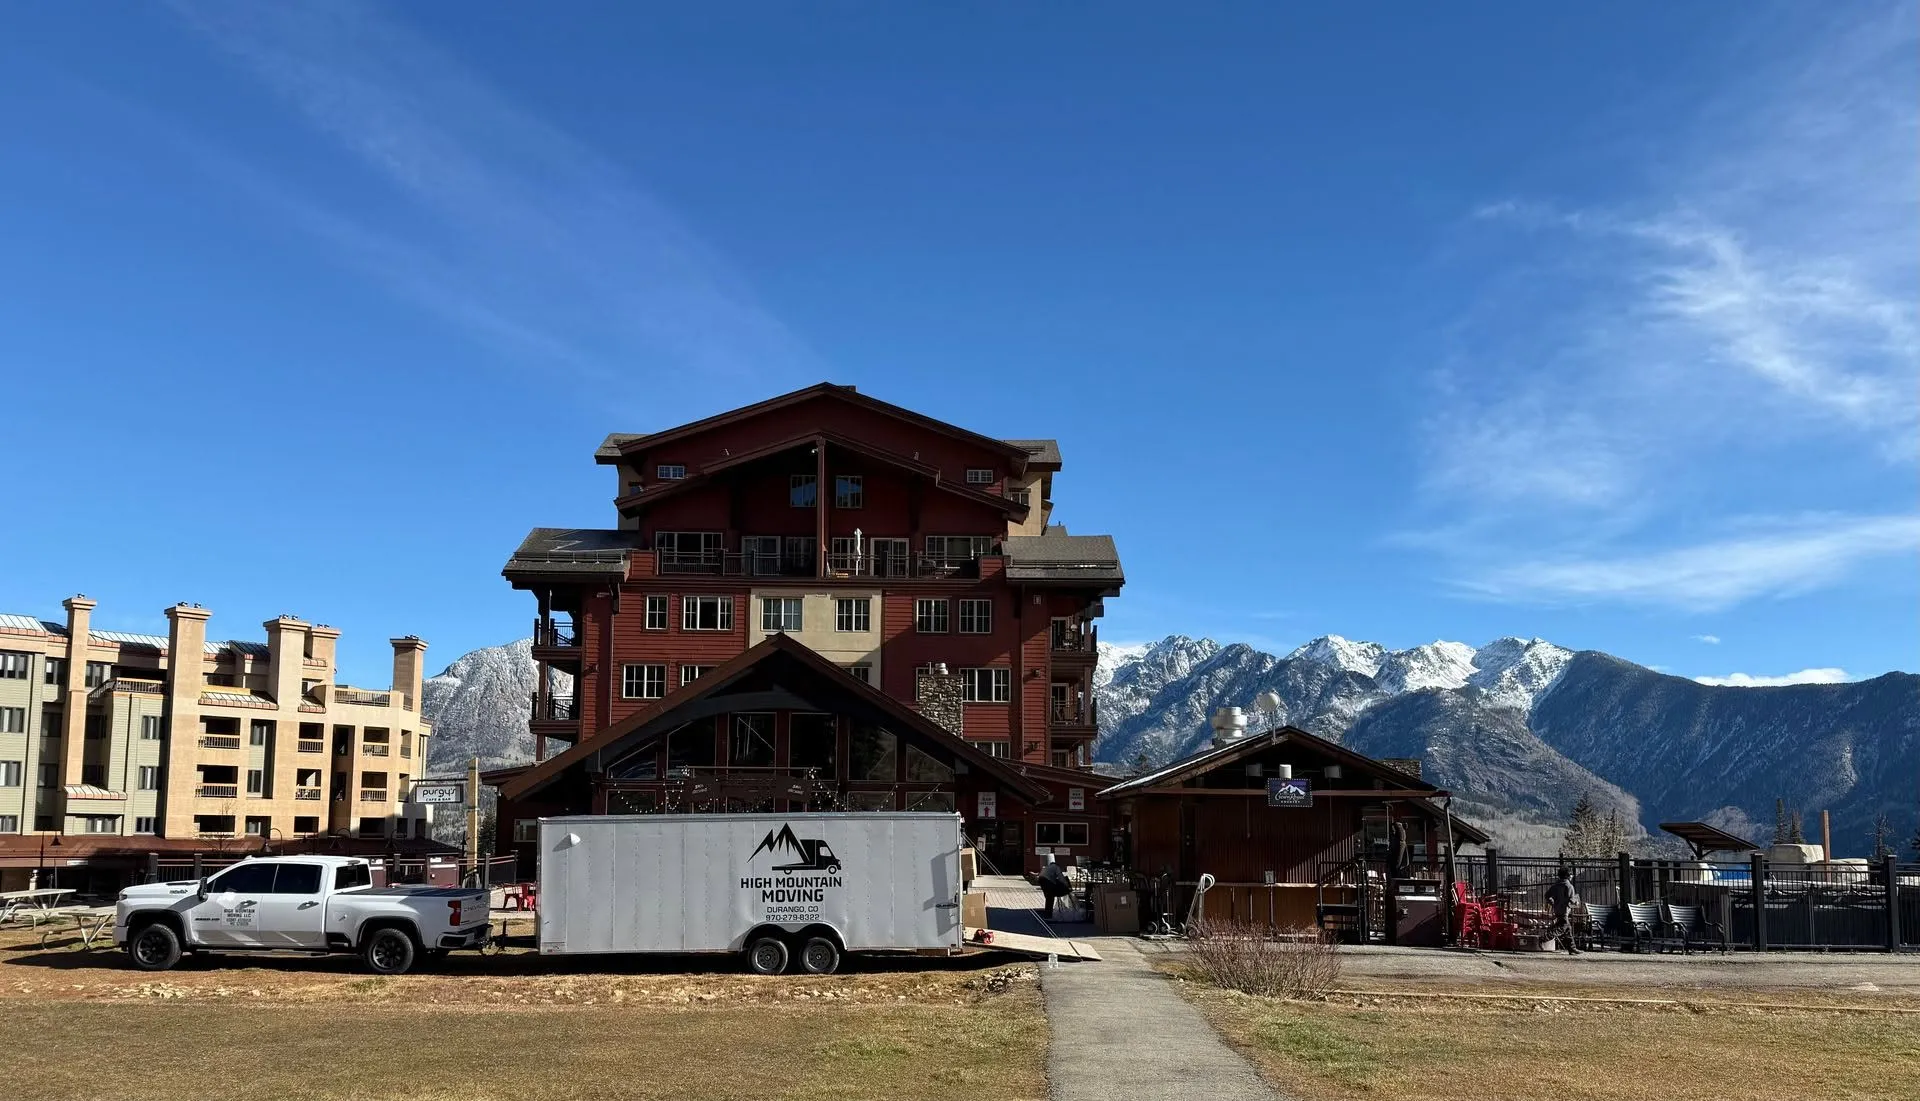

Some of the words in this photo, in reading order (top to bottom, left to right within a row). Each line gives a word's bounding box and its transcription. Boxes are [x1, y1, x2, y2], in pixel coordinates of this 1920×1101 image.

[422, 787, 456, 797] purgy's
[740, 877, 772, 889] HIGH
[775, 876, 842, 888] MOUNTAIN
[761, 888, 824, 903] MOVING
[766, 905, 807, 913] DURANGO,
[808, 905, 819, 913] CO
[765, 913, 820, 921] 970-279-8322
